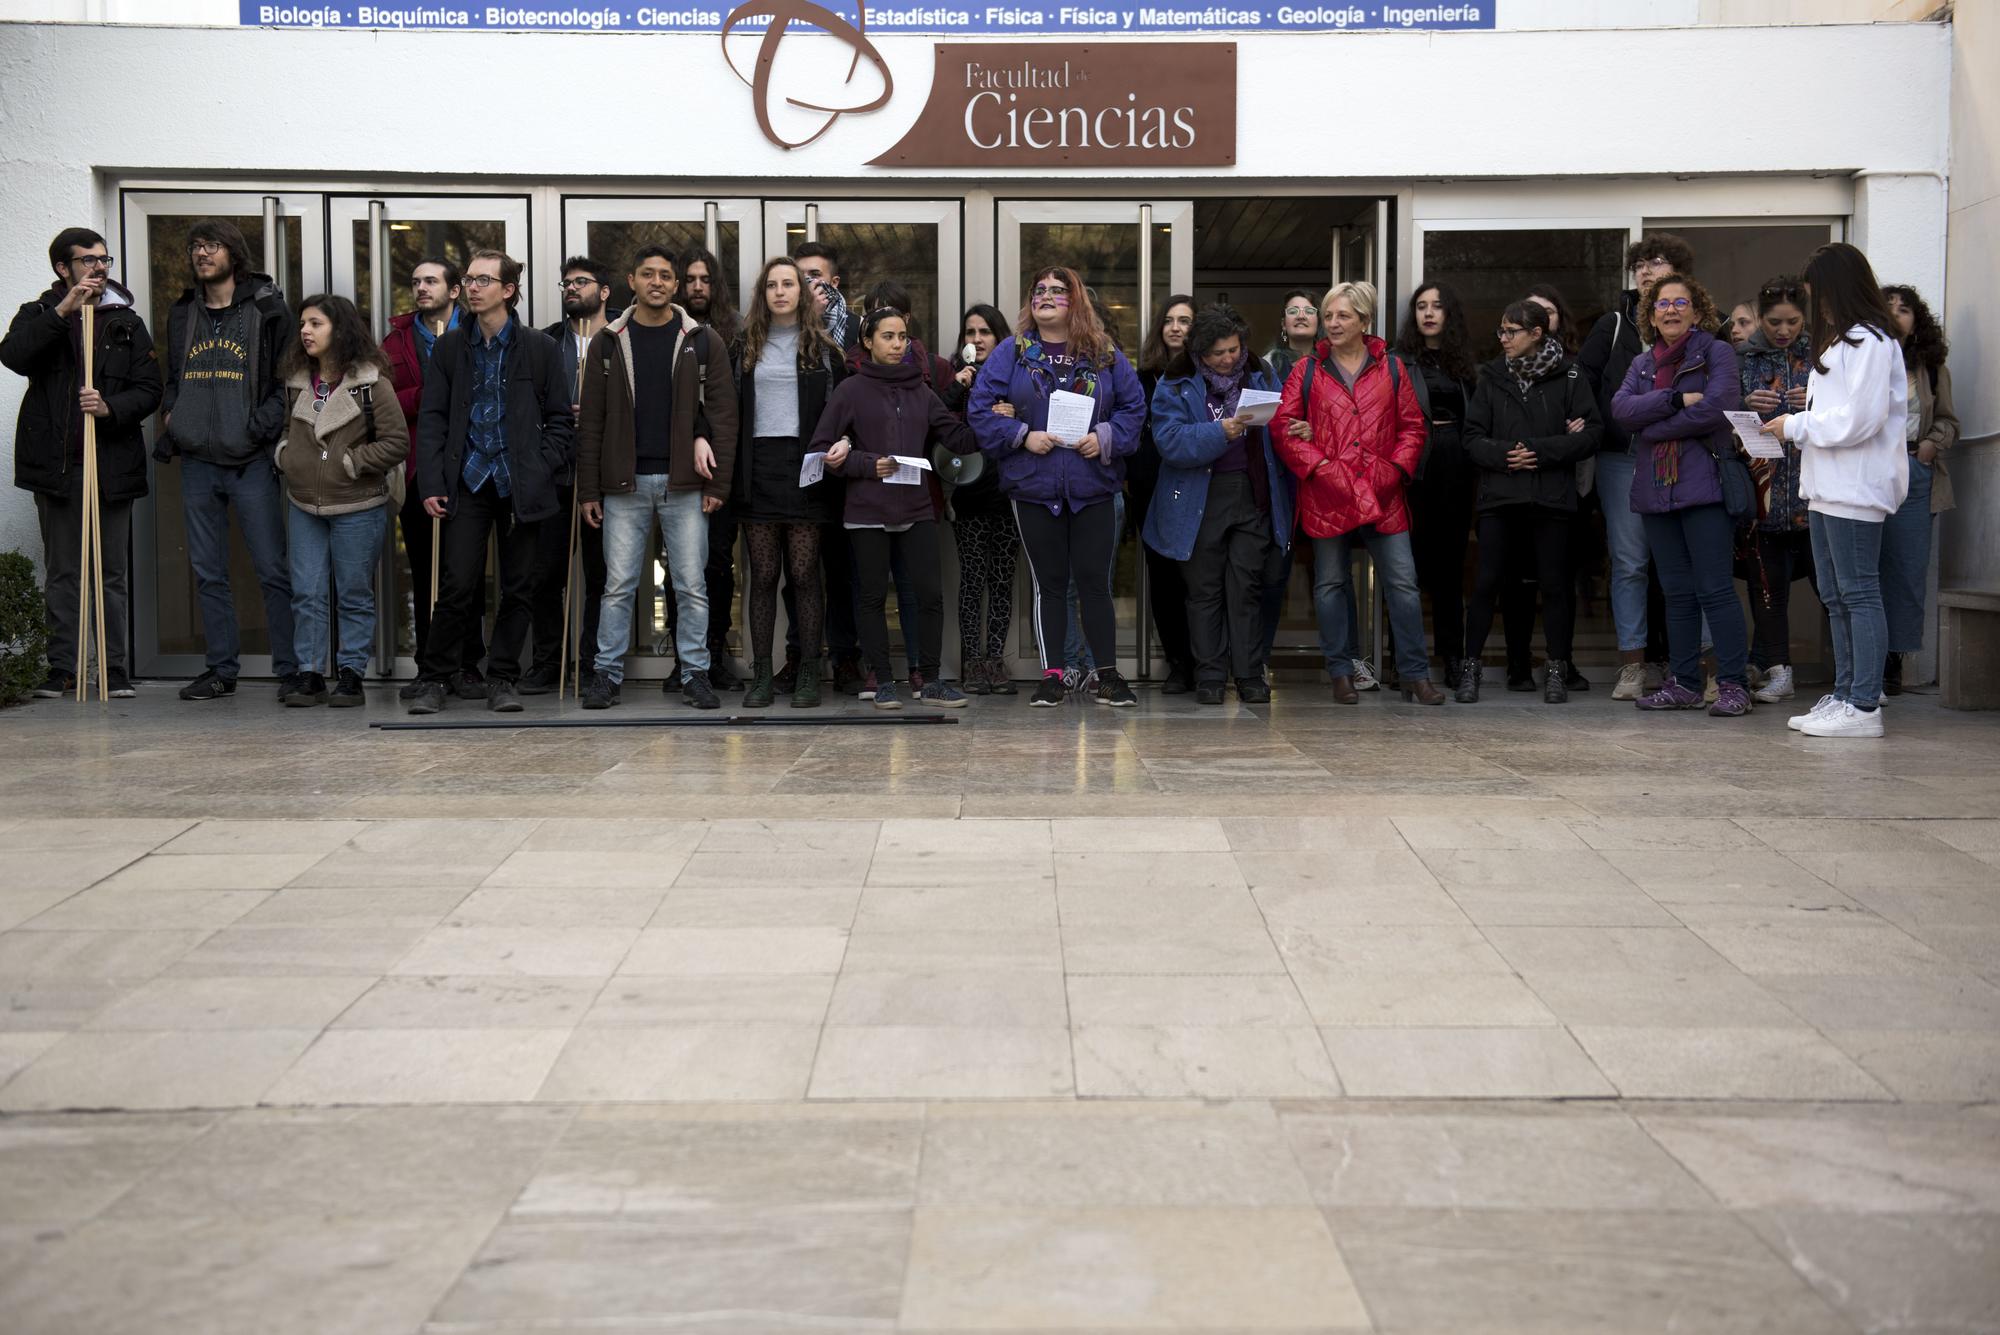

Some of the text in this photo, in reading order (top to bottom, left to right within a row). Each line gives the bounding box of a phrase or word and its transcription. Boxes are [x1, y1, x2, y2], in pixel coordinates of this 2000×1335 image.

[259, 6, 341, 26] Biología
[358, 6, 469, 27] Bioquímica
[486, 7, 621, 29] Biotecnología
[637, 8, 721, 26] Ciencias
[864, 7, 969, 25] Estadística
[986, 7, 1043, 25] Física
[1060, 7, 1117, 25] Física
[1122, 11, 1134, 29] y
[1139, 7, 1261, 25] Matemáticas
[1277, 6, 1365, 27] Geología
[1383, 4, 1480, 26] Ingeniería
[966, 61, 1069, 88] Facultad
[964, 91, 1196, 149] Ciencias
